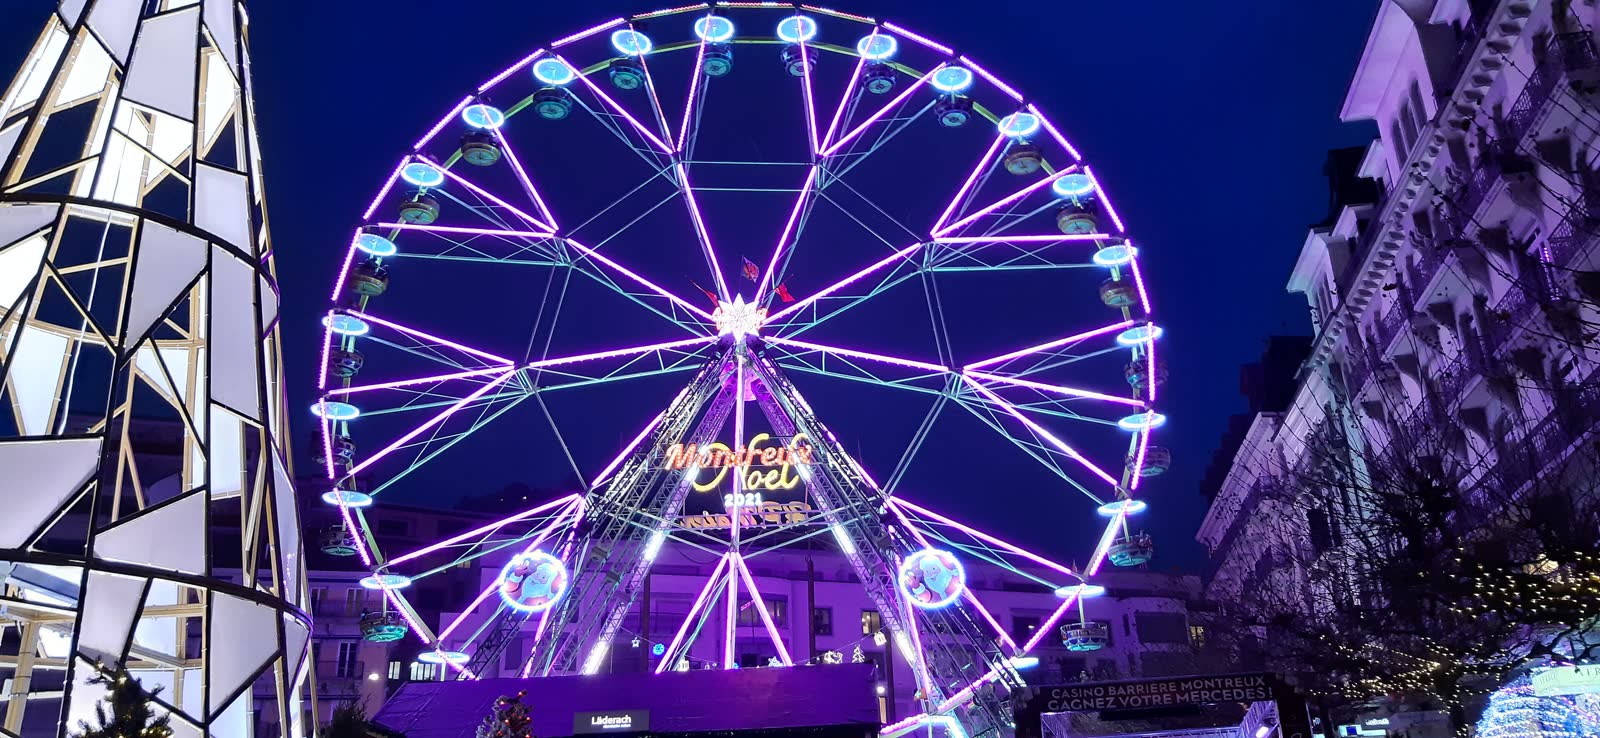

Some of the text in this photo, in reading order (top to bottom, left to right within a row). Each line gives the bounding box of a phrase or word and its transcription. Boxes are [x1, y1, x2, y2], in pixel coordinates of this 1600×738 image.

[665, 443, 812, 470] Montreux
[724, 492, 762, 507] 2021
[1051, 686, 1105, 699] CASINO
[1181, 676, 1265, 690] MONTREUX
[1047, 697, 1117, 711] GAGNEZ
[1119, 693, 1172, 707] VOTRE
[591, 714, 632, 725] Läderach
